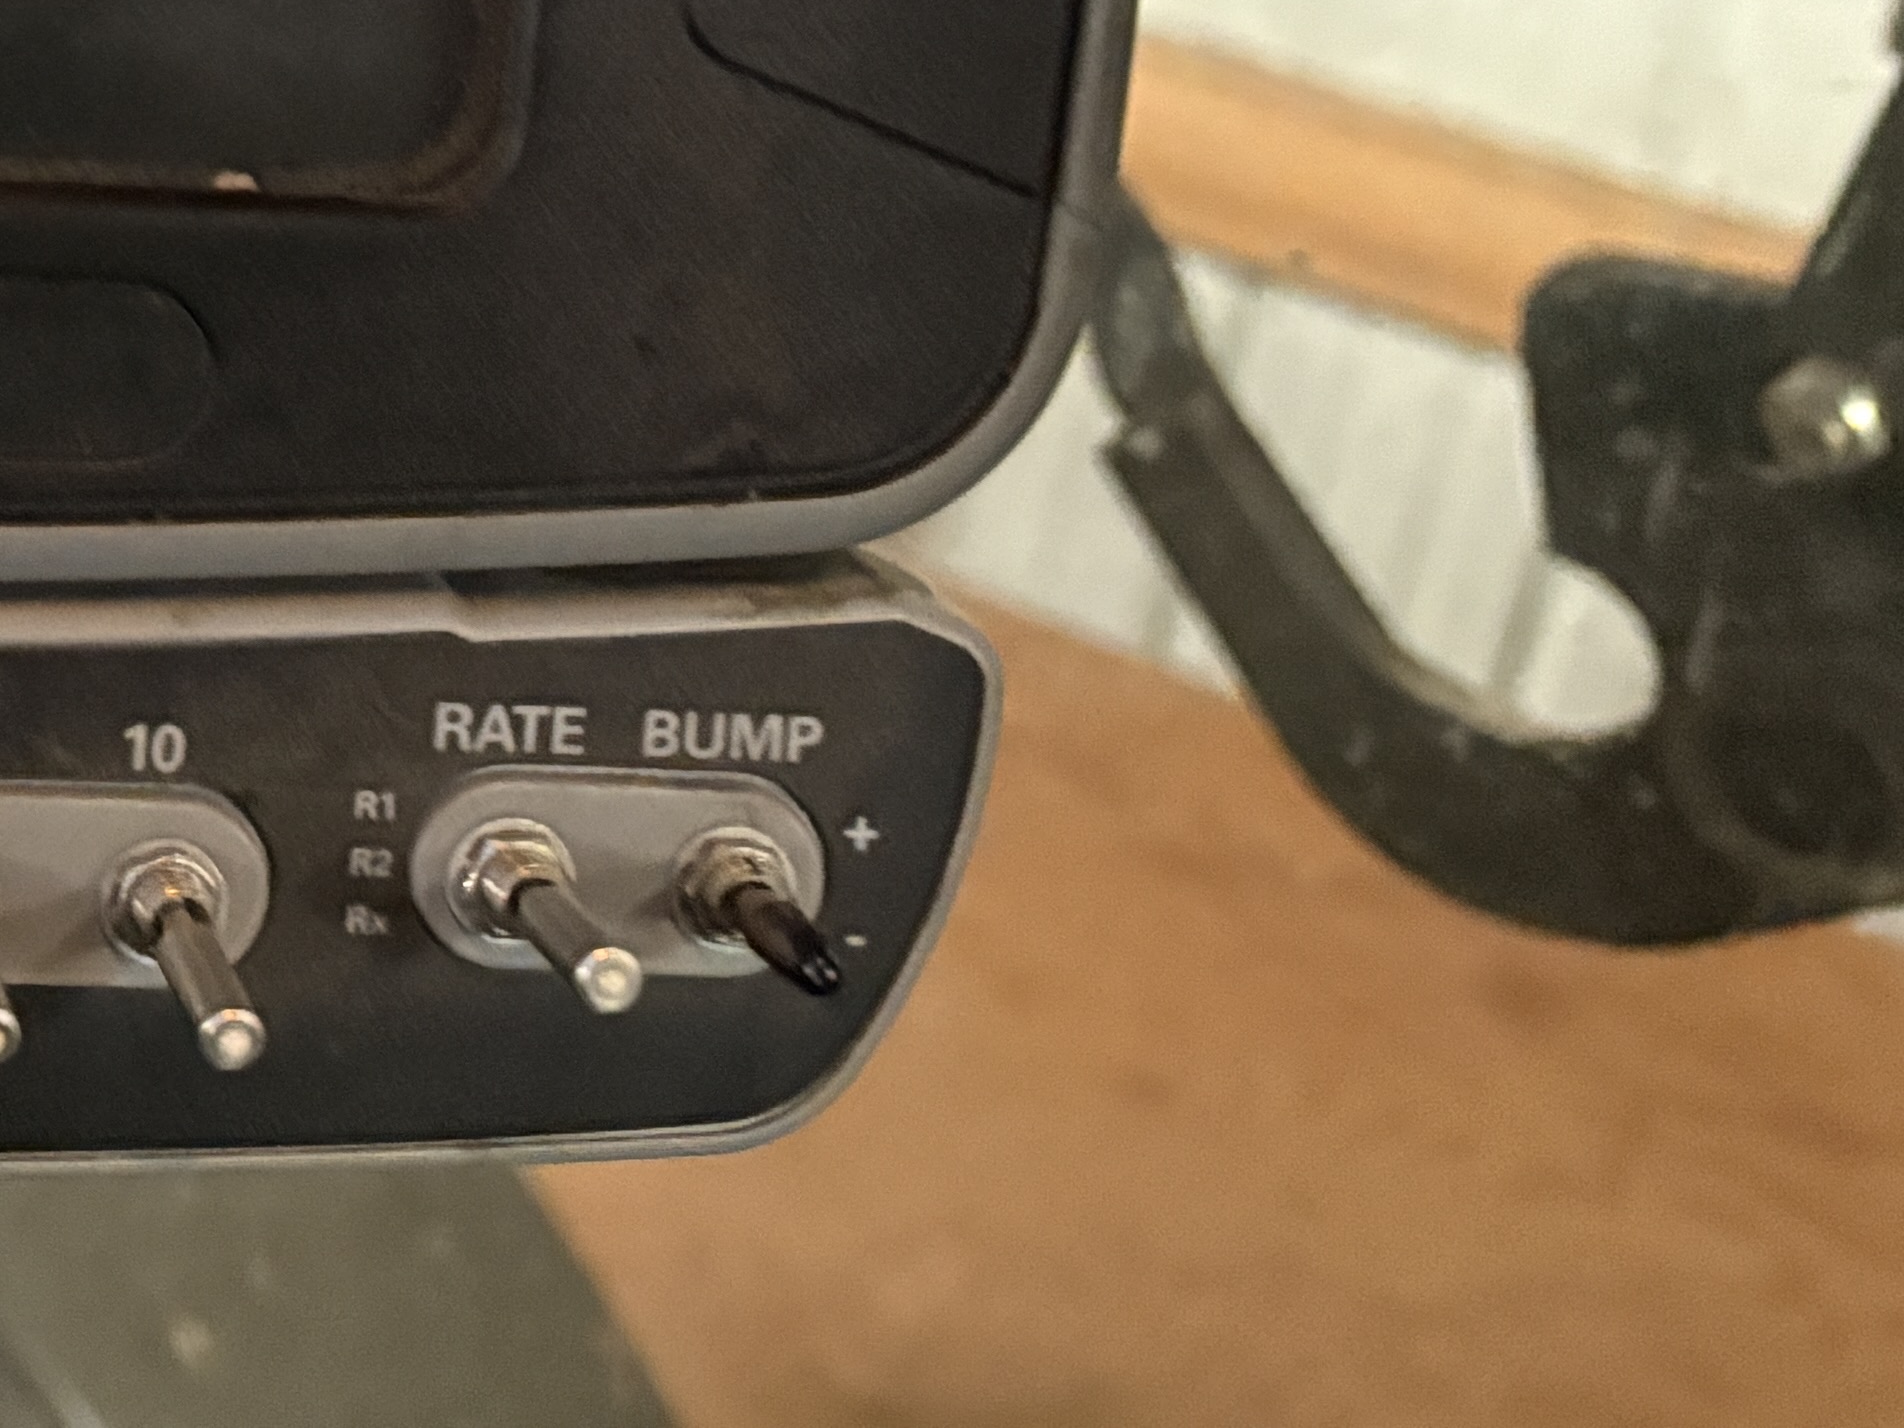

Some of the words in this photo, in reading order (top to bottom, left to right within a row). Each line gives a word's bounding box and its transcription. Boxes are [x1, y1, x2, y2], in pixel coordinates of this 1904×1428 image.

[123, 722, 188, 775] 10
[432, 700, 588, 757] RATE
[641, 708, 825, 764] BUMP
[352, 788, 397, 821] R1
[348, 845, 395, 879] R2
